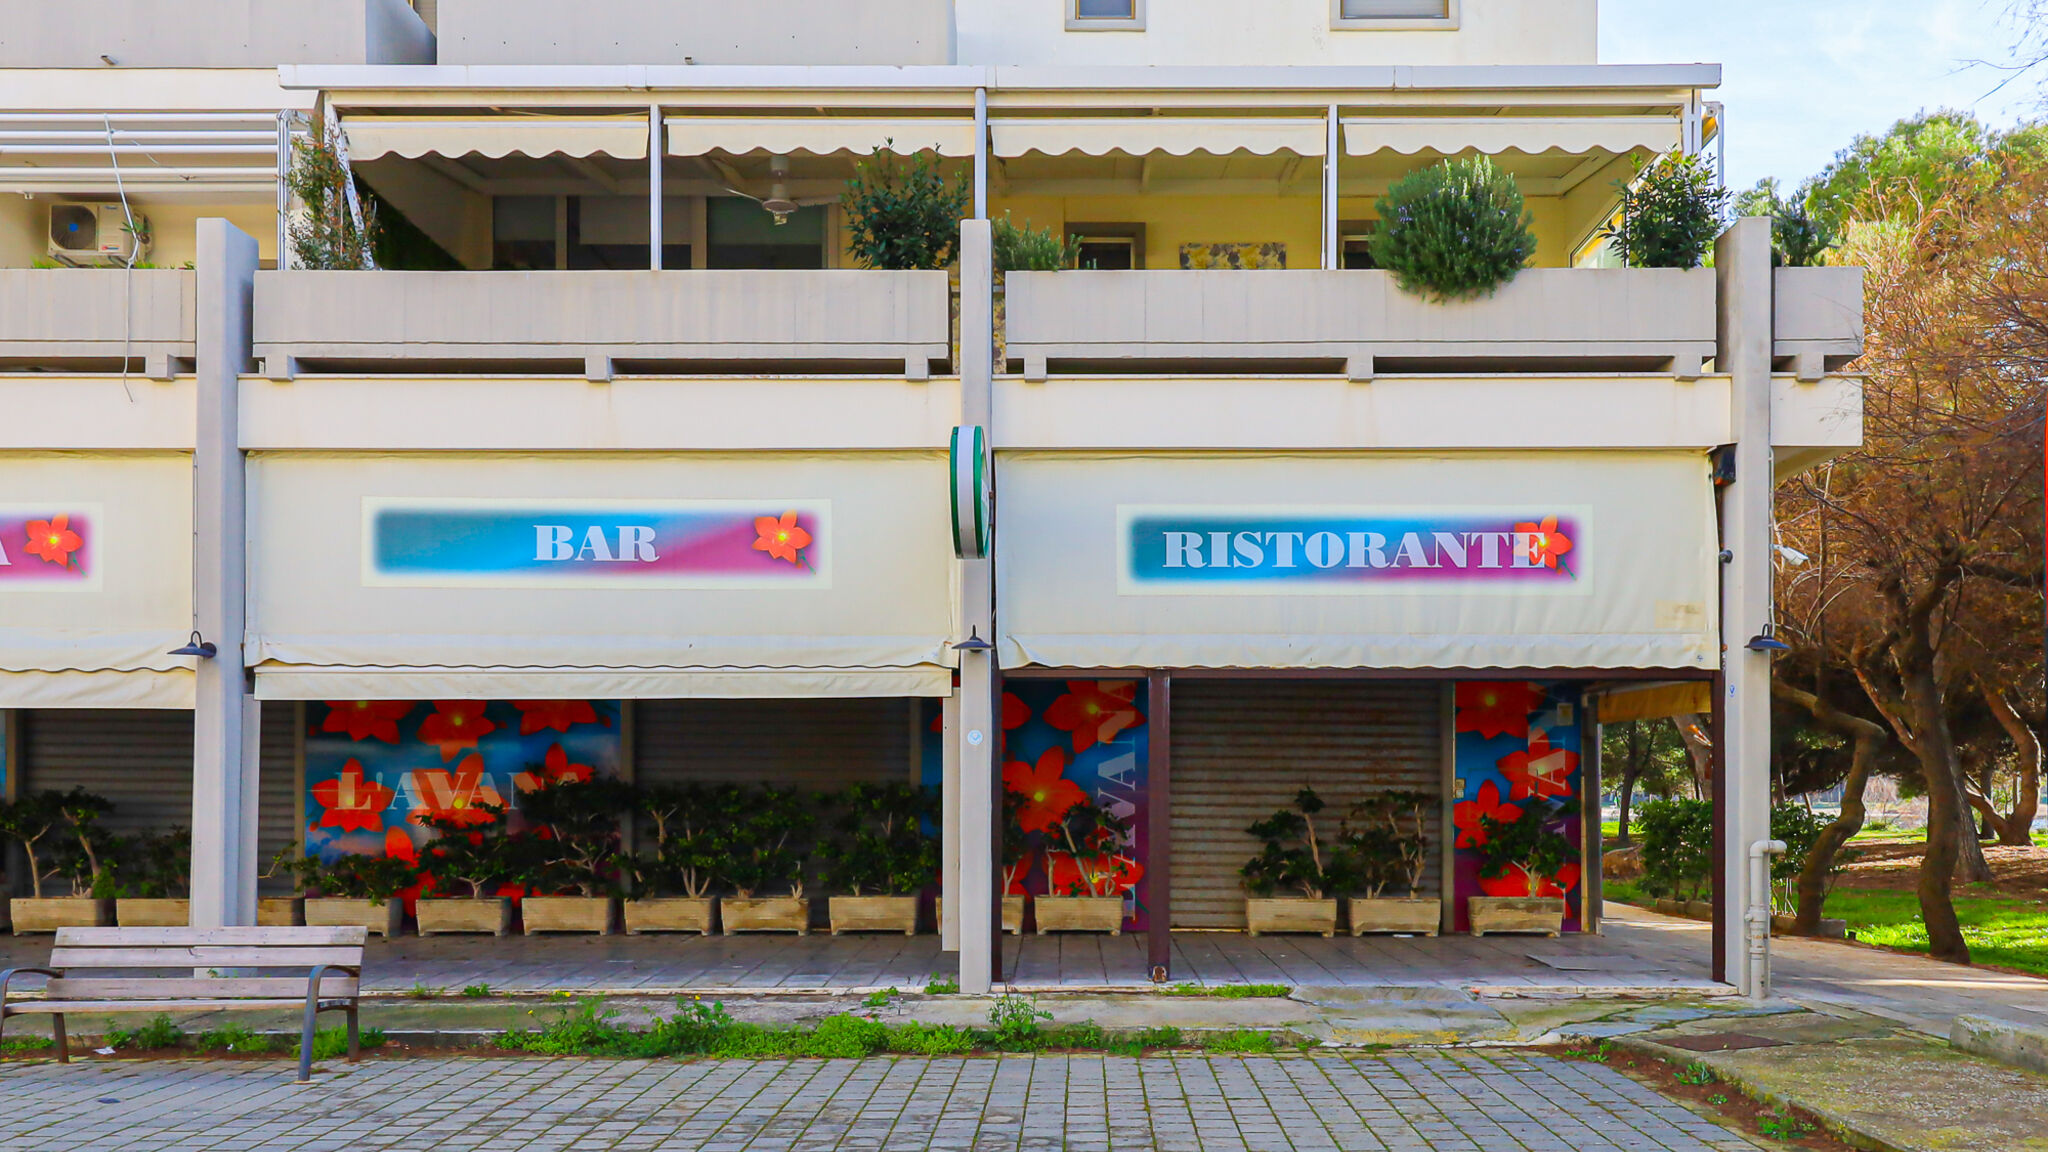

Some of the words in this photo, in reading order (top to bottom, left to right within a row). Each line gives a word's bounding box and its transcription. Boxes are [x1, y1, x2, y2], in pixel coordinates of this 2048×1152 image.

[533, 525, 660, 562] BAR
[1162, 531, 1546, 568] RISTORANTE
[334, 771, 579, 811] L'AVAN
